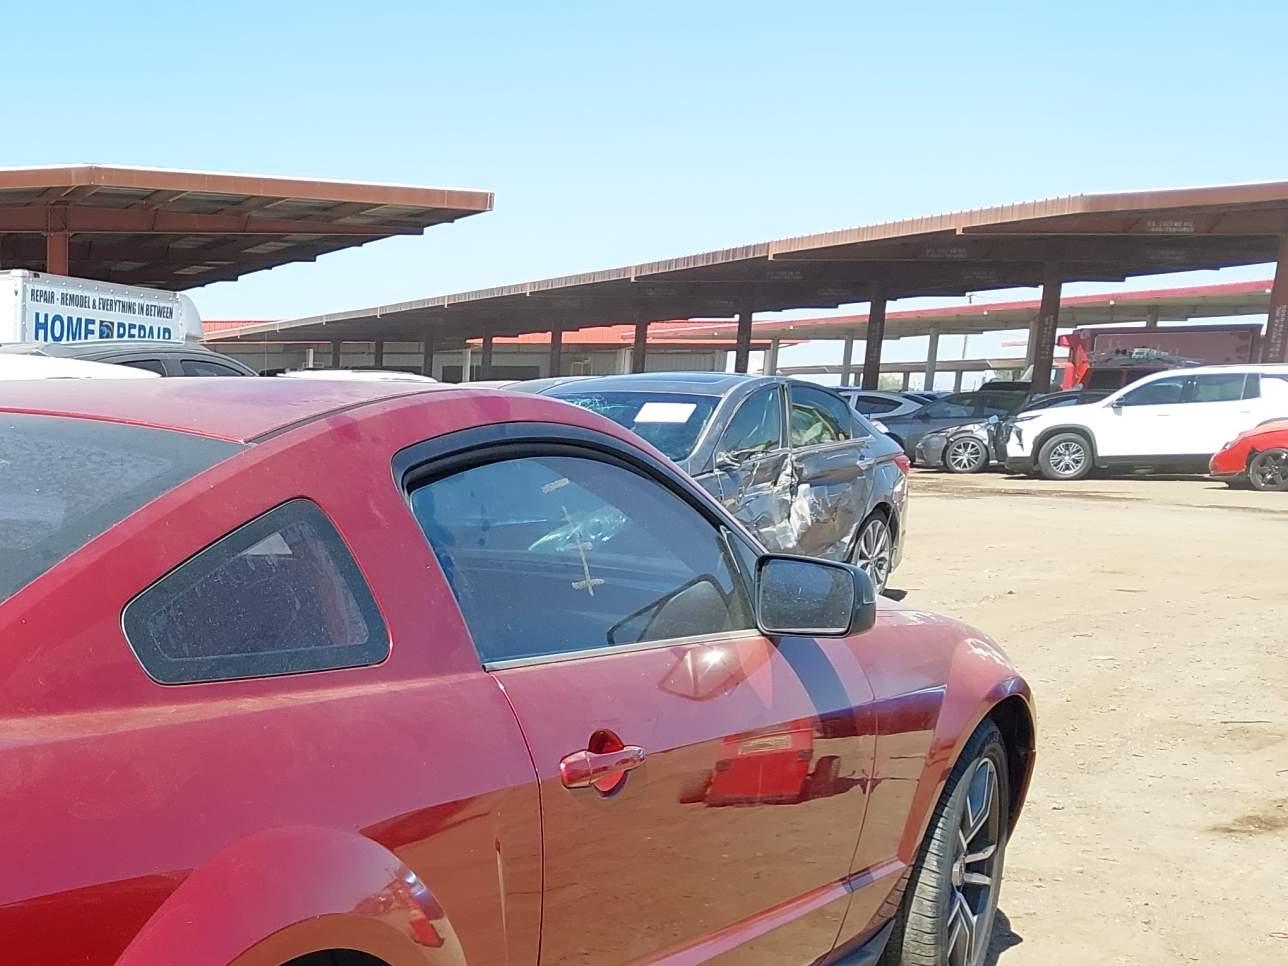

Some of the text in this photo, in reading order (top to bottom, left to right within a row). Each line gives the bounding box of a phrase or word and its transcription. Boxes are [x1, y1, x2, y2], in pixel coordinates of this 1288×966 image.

[30, 288, 55, 304] REPAIR
[60, 292, 91, 309] REMODEL
[92, 298, 97, 310] &
[98, 296, 136, 315] EVERYTHING
[137, 302, 145, 316] IN
[145, 304, 174, 320] BETWEEN
